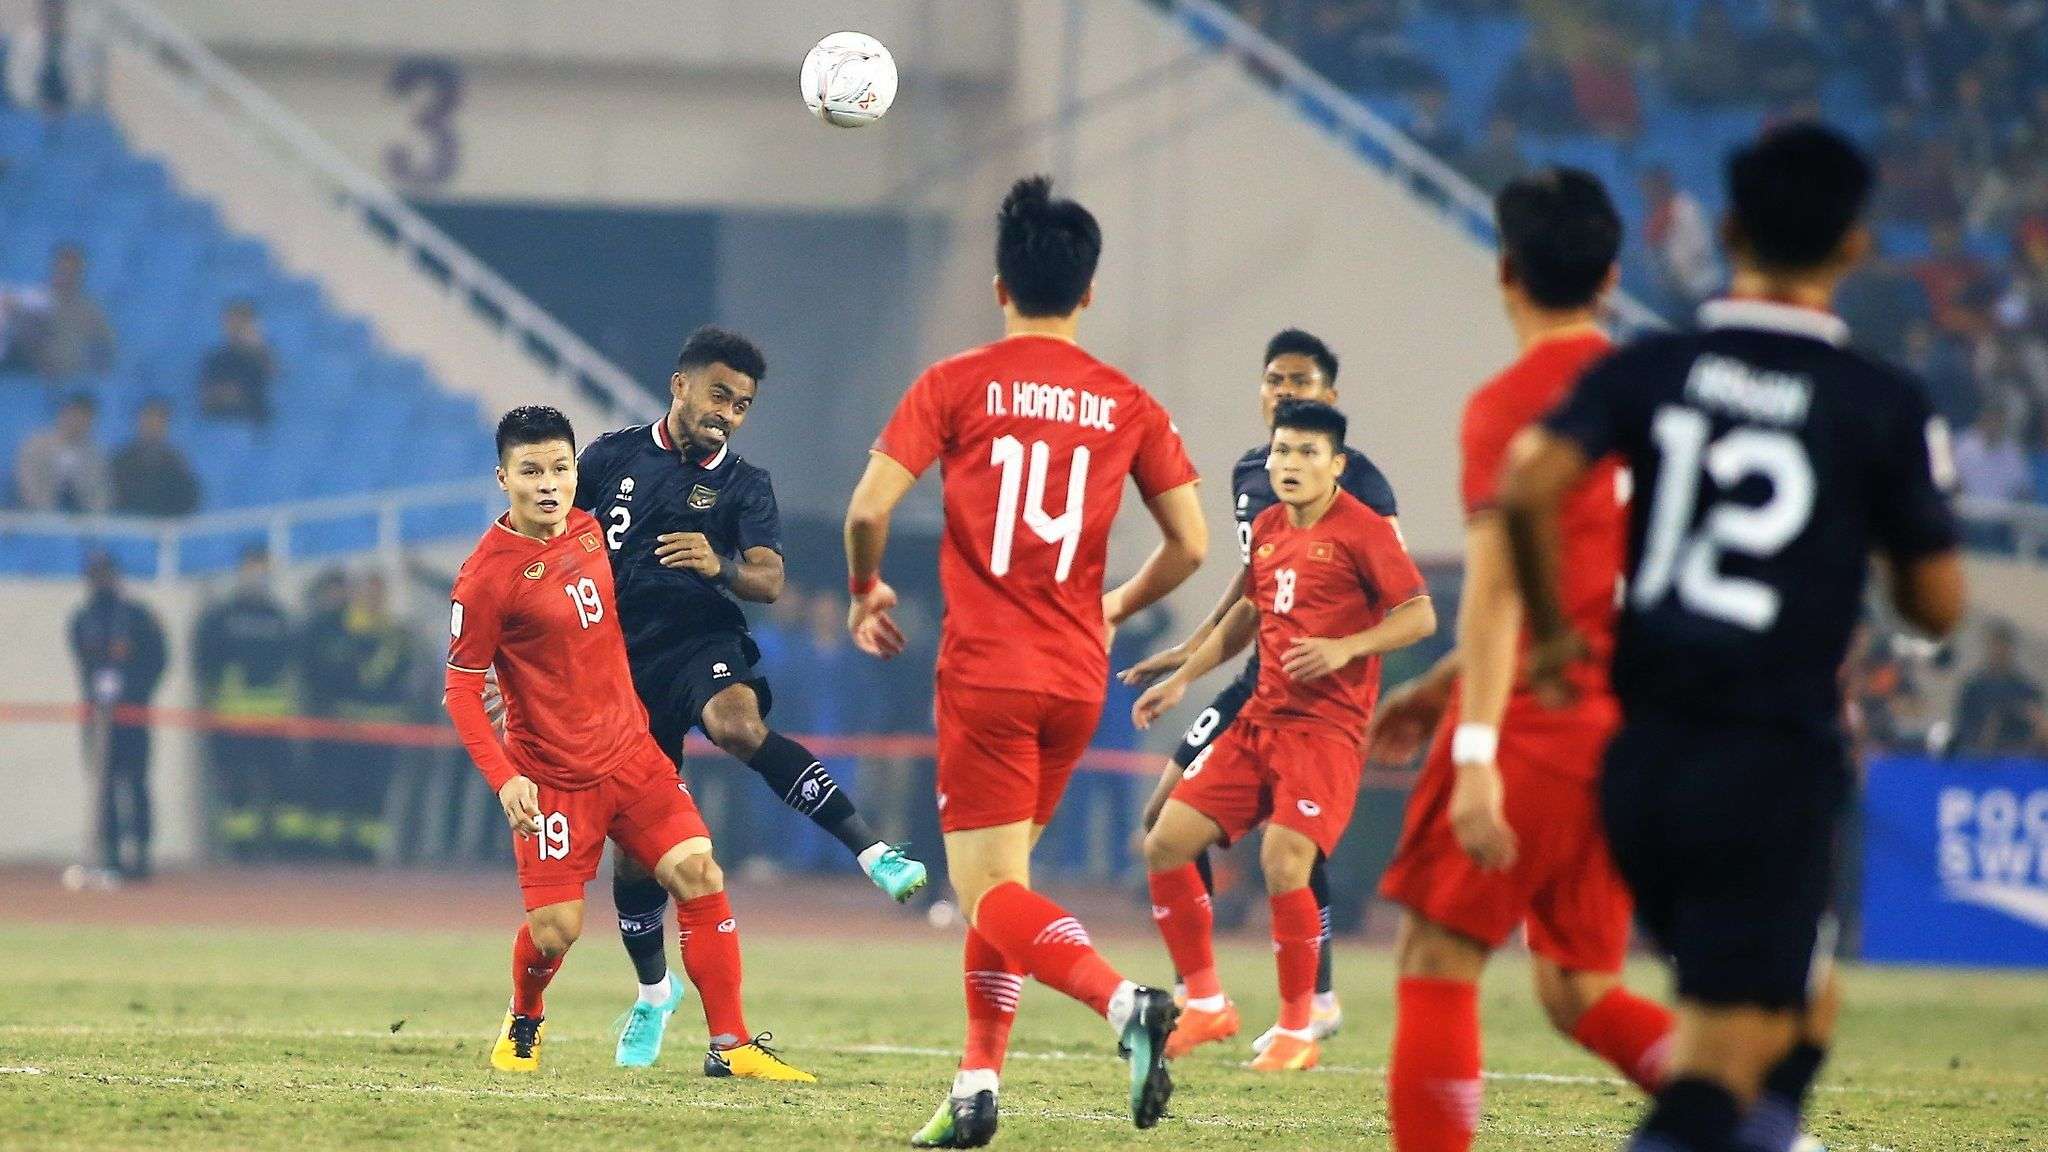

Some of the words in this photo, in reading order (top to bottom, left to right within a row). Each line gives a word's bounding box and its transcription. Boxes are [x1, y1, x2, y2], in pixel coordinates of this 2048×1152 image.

[386, 53, 462, 188] 3
[1012, 381, 1076, 423] HOANG
[1079, 389, 1117, 432] DUC
[606, 505, 632, 550] 2
[990, 434, 1091, 583] 14
[1630, 405, 1816, 631] 12
[564, 576, 604, 630] 19
[1273, 567, 1297, 614] 18
[1186, 706, 1221, 748] 9
[532, 811, 570, 861] 19
